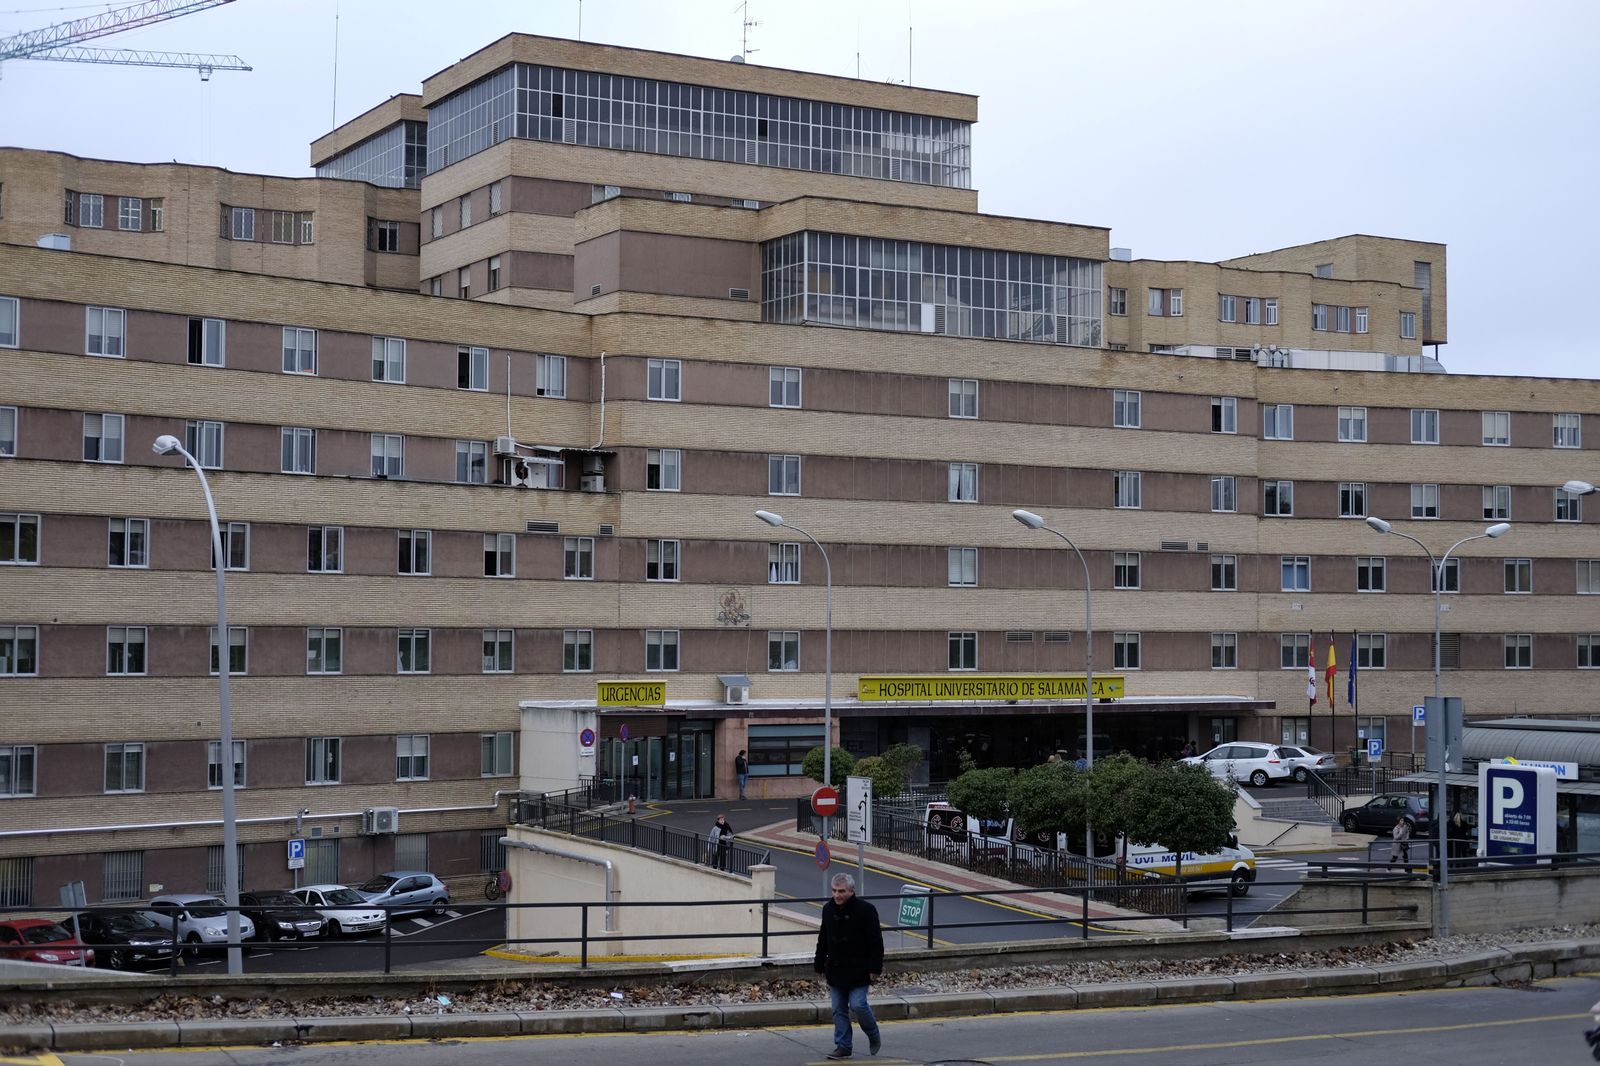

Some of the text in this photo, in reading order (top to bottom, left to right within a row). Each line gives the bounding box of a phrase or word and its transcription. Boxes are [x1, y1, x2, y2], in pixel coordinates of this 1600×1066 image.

[602, 687, 661, 702] URGENCIAS
[879, 682, 932, 697] HOSPITAL
[935, 682, 1019, 697] UNIVERSITARIO
[1022, 682, 1035, 696] DE
[1038, 681, 1105, 696] SALAMANCA
[1416, 708, 1425, 720] P
[1371, 742, 1379, 755] P
[1493, 777, 1524, 825] P
[291, 842, 301, 858] P
[902, 905, 920, 917] STOP
